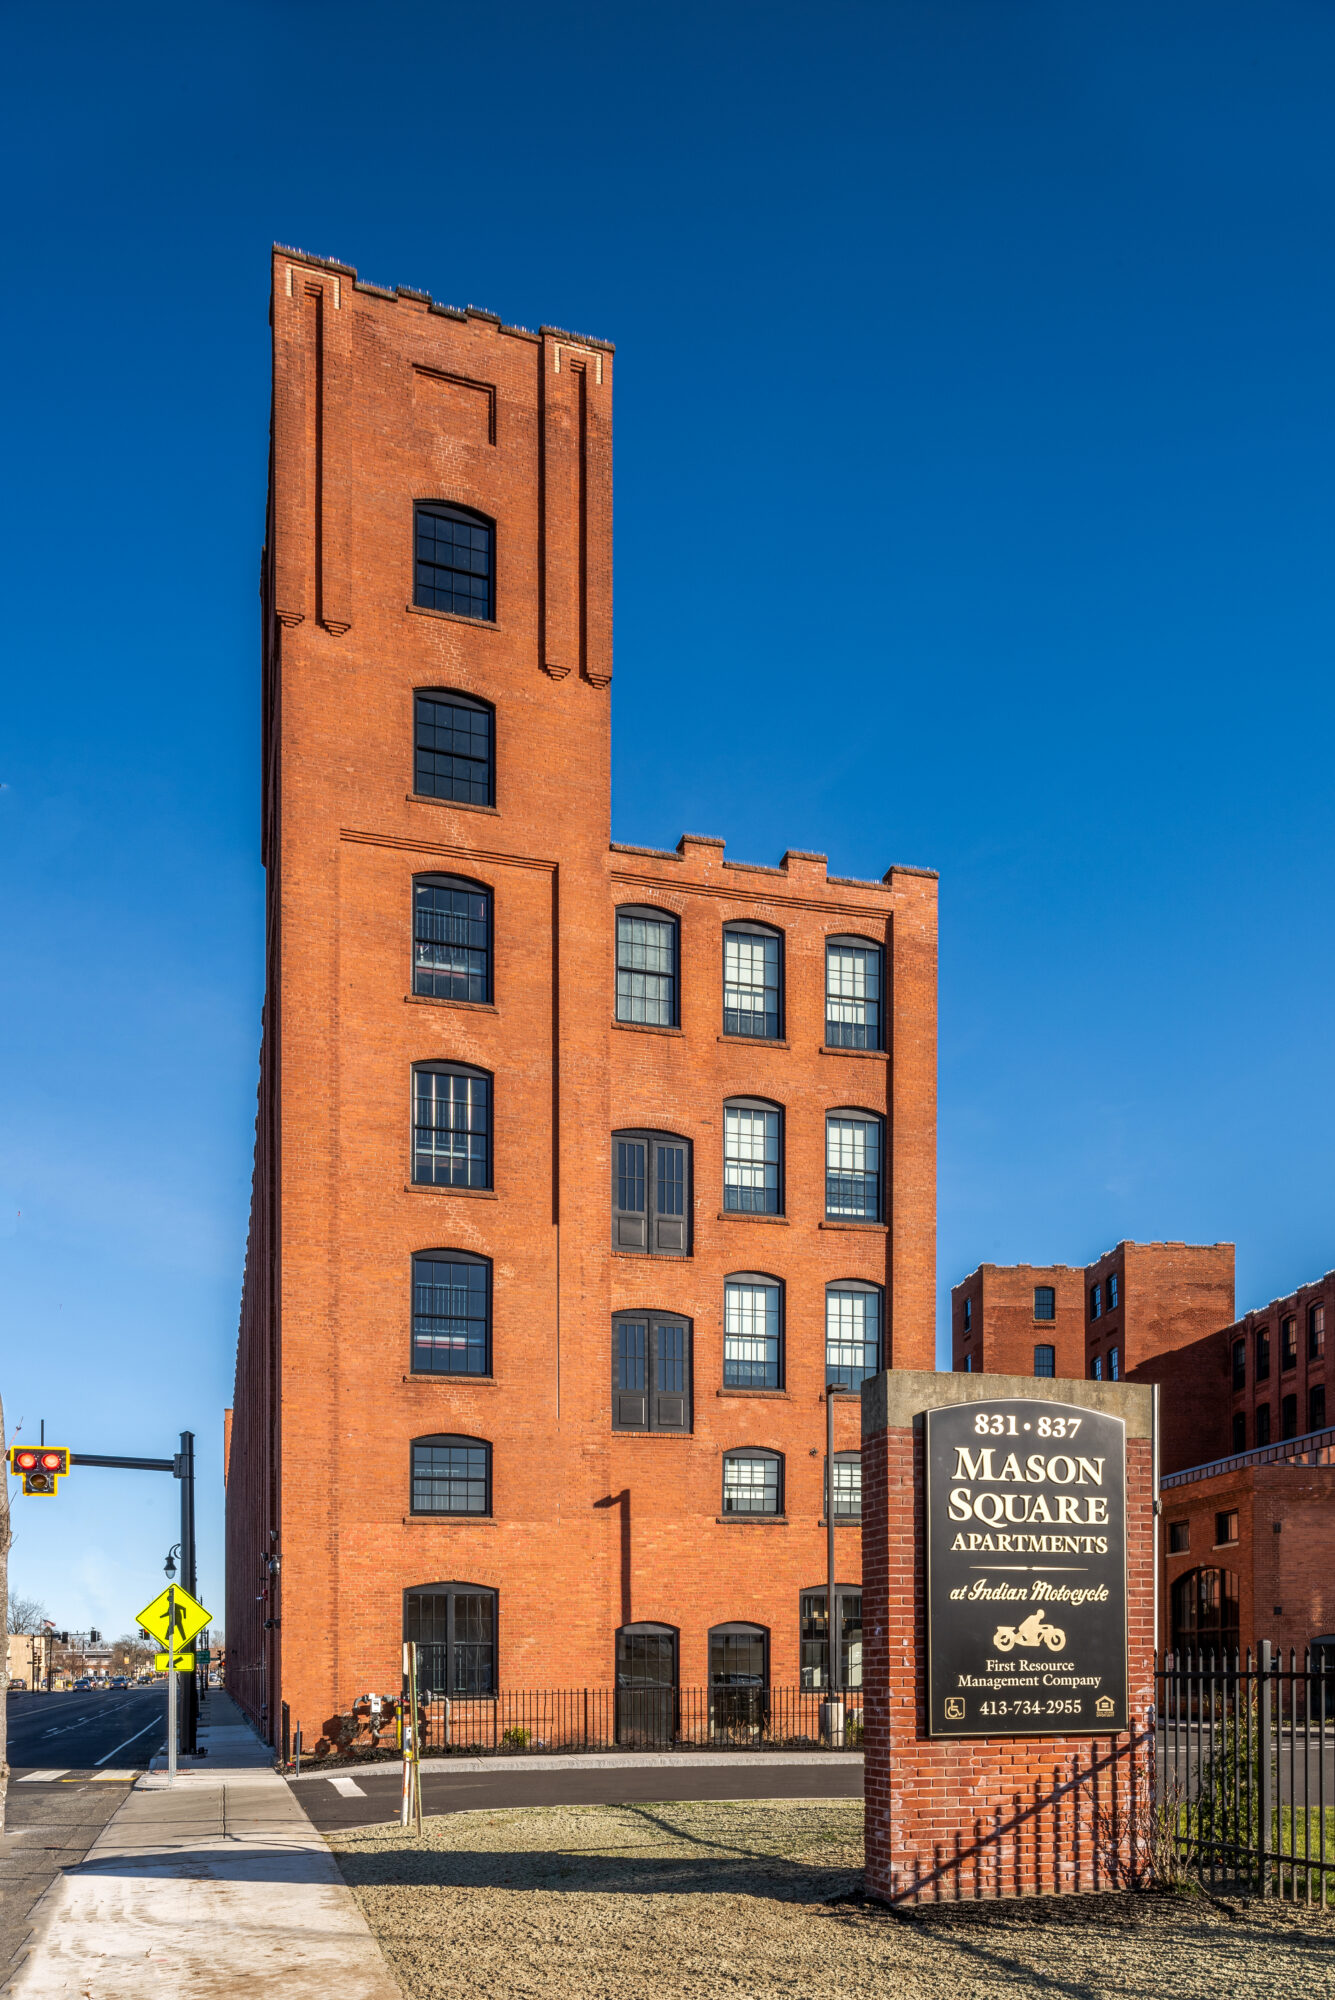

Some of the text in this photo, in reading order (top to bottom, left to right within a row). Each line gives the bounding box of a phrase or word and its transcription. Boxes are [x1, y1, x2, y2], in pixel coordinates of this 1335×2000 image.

[951, 1446, 1106, 1487] MASON
[948, 1487, 1109, 1528] SQUARE
[950, 1533, 1108, 1554] APARTMENTS
[950, 1578, 1109, 1606] at Indian Motocycle
[986, 1659, 1075, 1672] First Resource
[957, 1673, 1102, 1690] Management Company
[979, 1699, 1082, 1716] 413-734-2955
